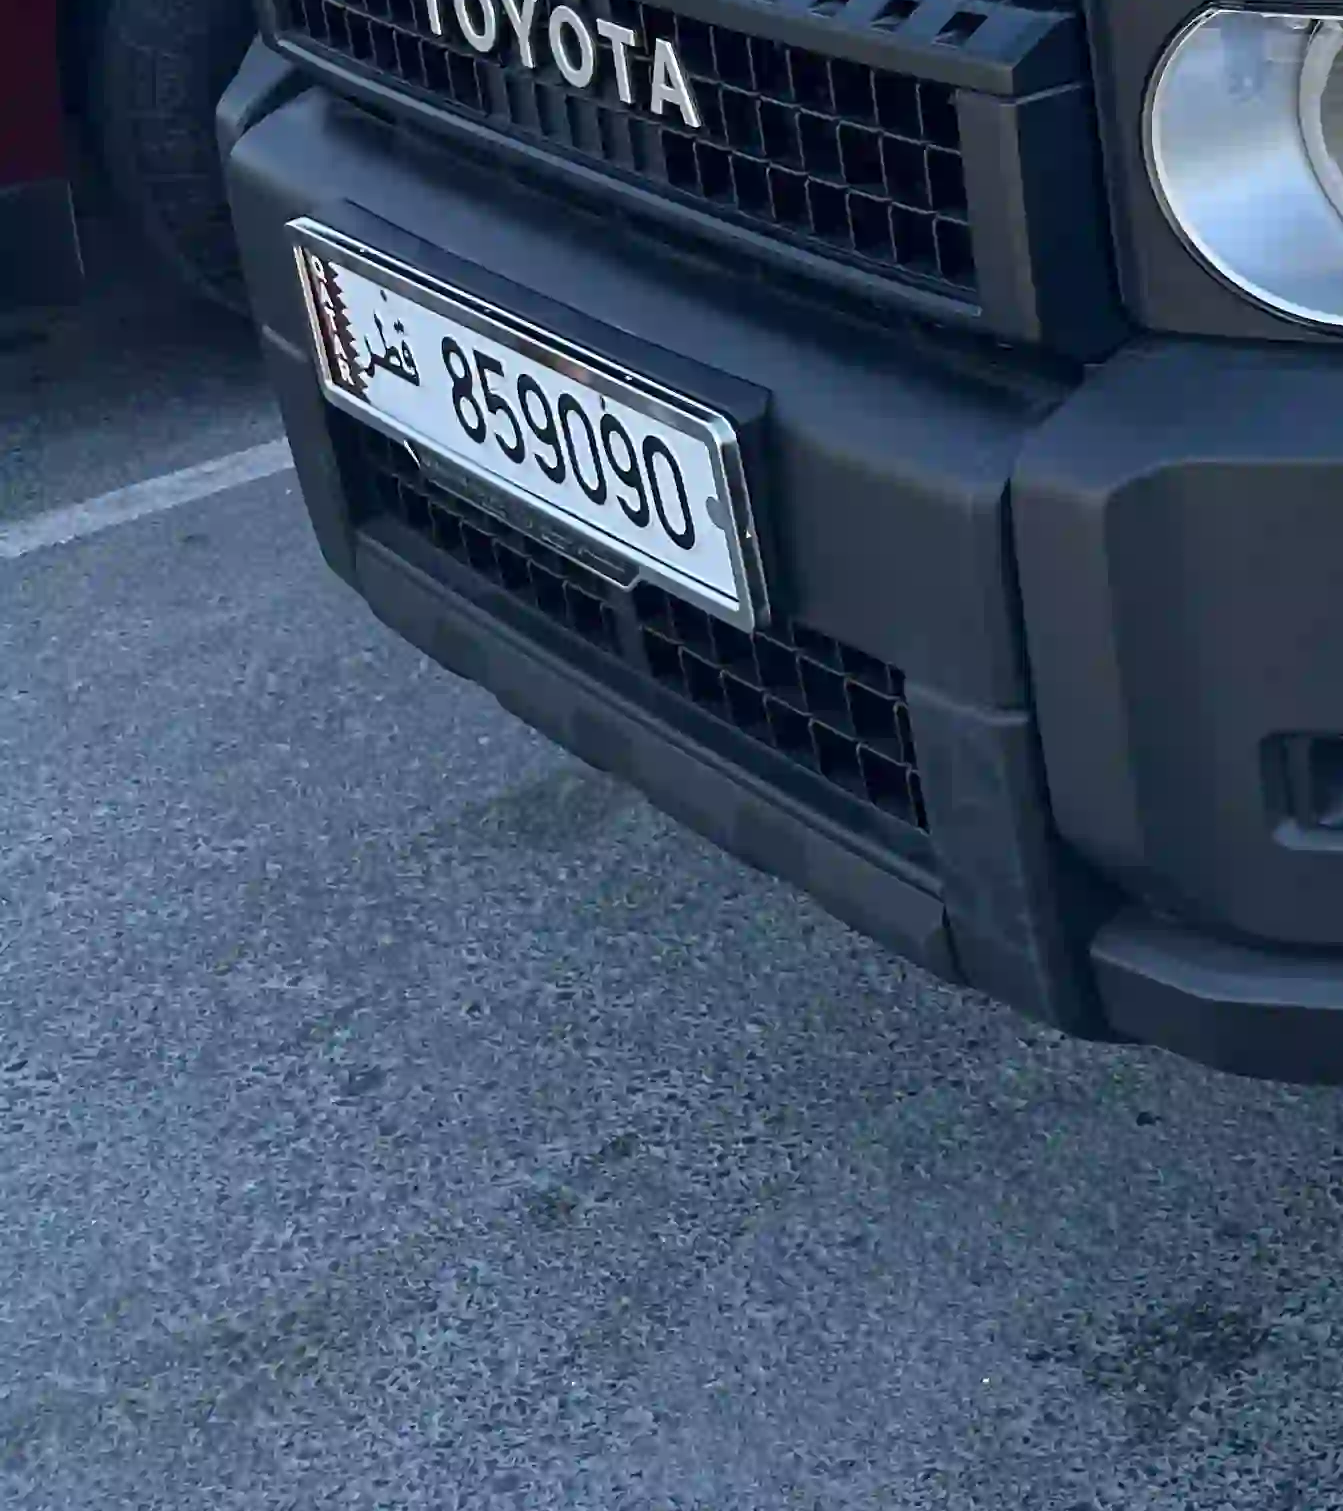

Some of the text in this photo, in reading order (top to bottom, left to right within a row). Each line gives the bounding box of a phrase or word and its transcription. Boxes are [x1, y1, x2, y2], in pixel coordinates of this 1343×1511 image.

[311, 254, 356, 387] QATAR
[363, 308, 421, 387] قطر
[441, 335, 696, 551] 859090
